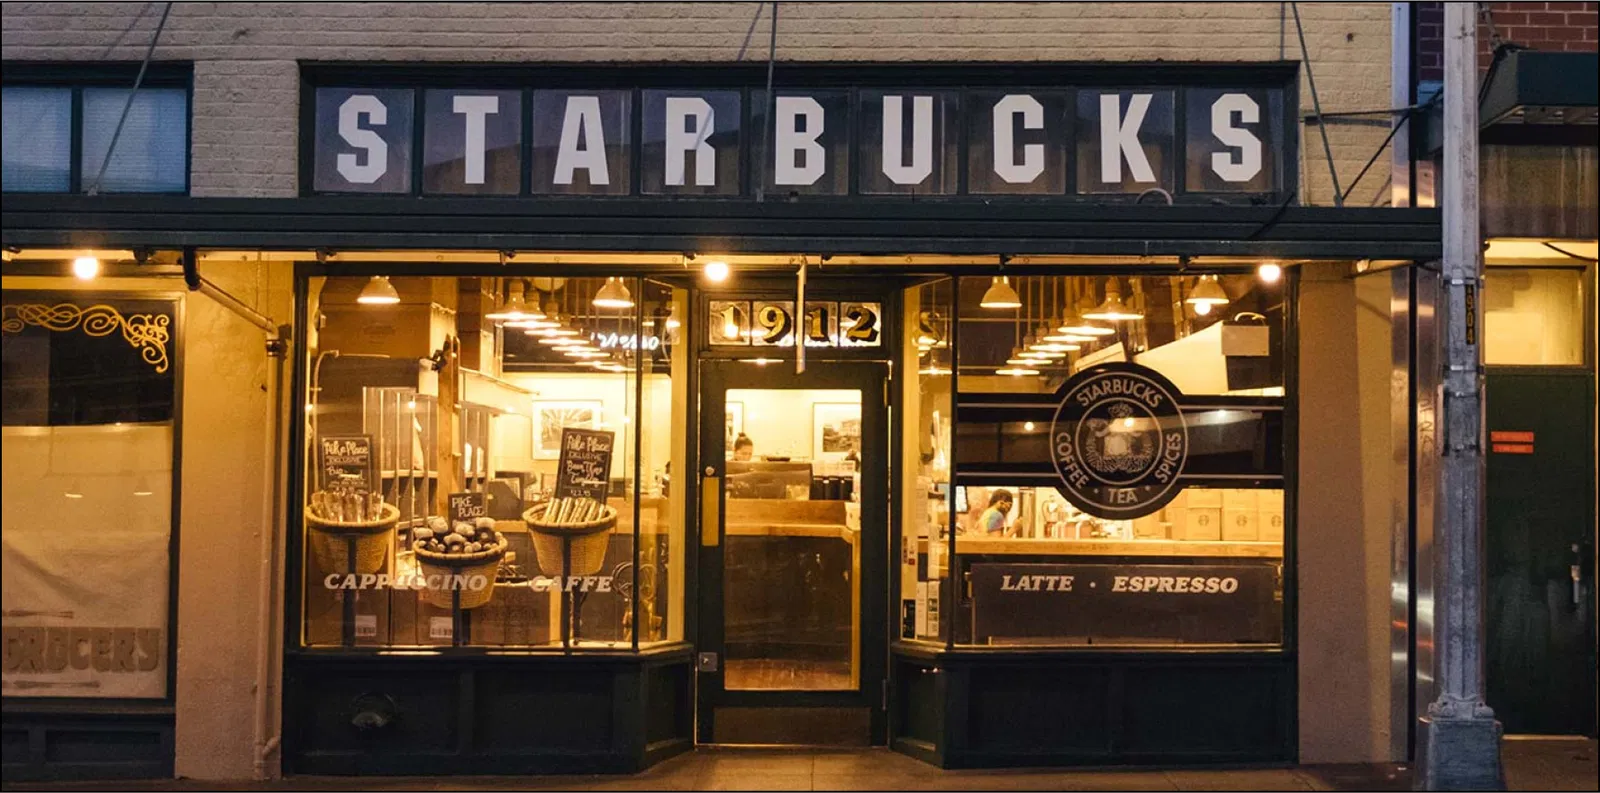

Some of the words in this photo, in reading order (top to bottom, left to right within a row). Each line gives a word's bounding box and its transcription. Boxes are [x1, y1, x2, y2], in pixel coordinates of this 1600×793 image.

[337, 93, 1262, 186] STARBUCKS
[720, 305, 879, 343] 1912
[1076, 378, 1163, 408] STARBUCKS
[1056, 432, 1090, 489] COFFEE
[1107, 488, 1138, 504] TEA
[1154, 432, 1182, 484] SPICES
[451, 496, 473, 509] PIKE
[458, 506, 485, 518] PLACE
[324, 573, 489, 591] CAPPUCCINO
[530, 575, 614, 593] CAFFE
[1000, 575, 1074, 592] LATTE
[1112, 576, 1239, 593] ESPRESSO
